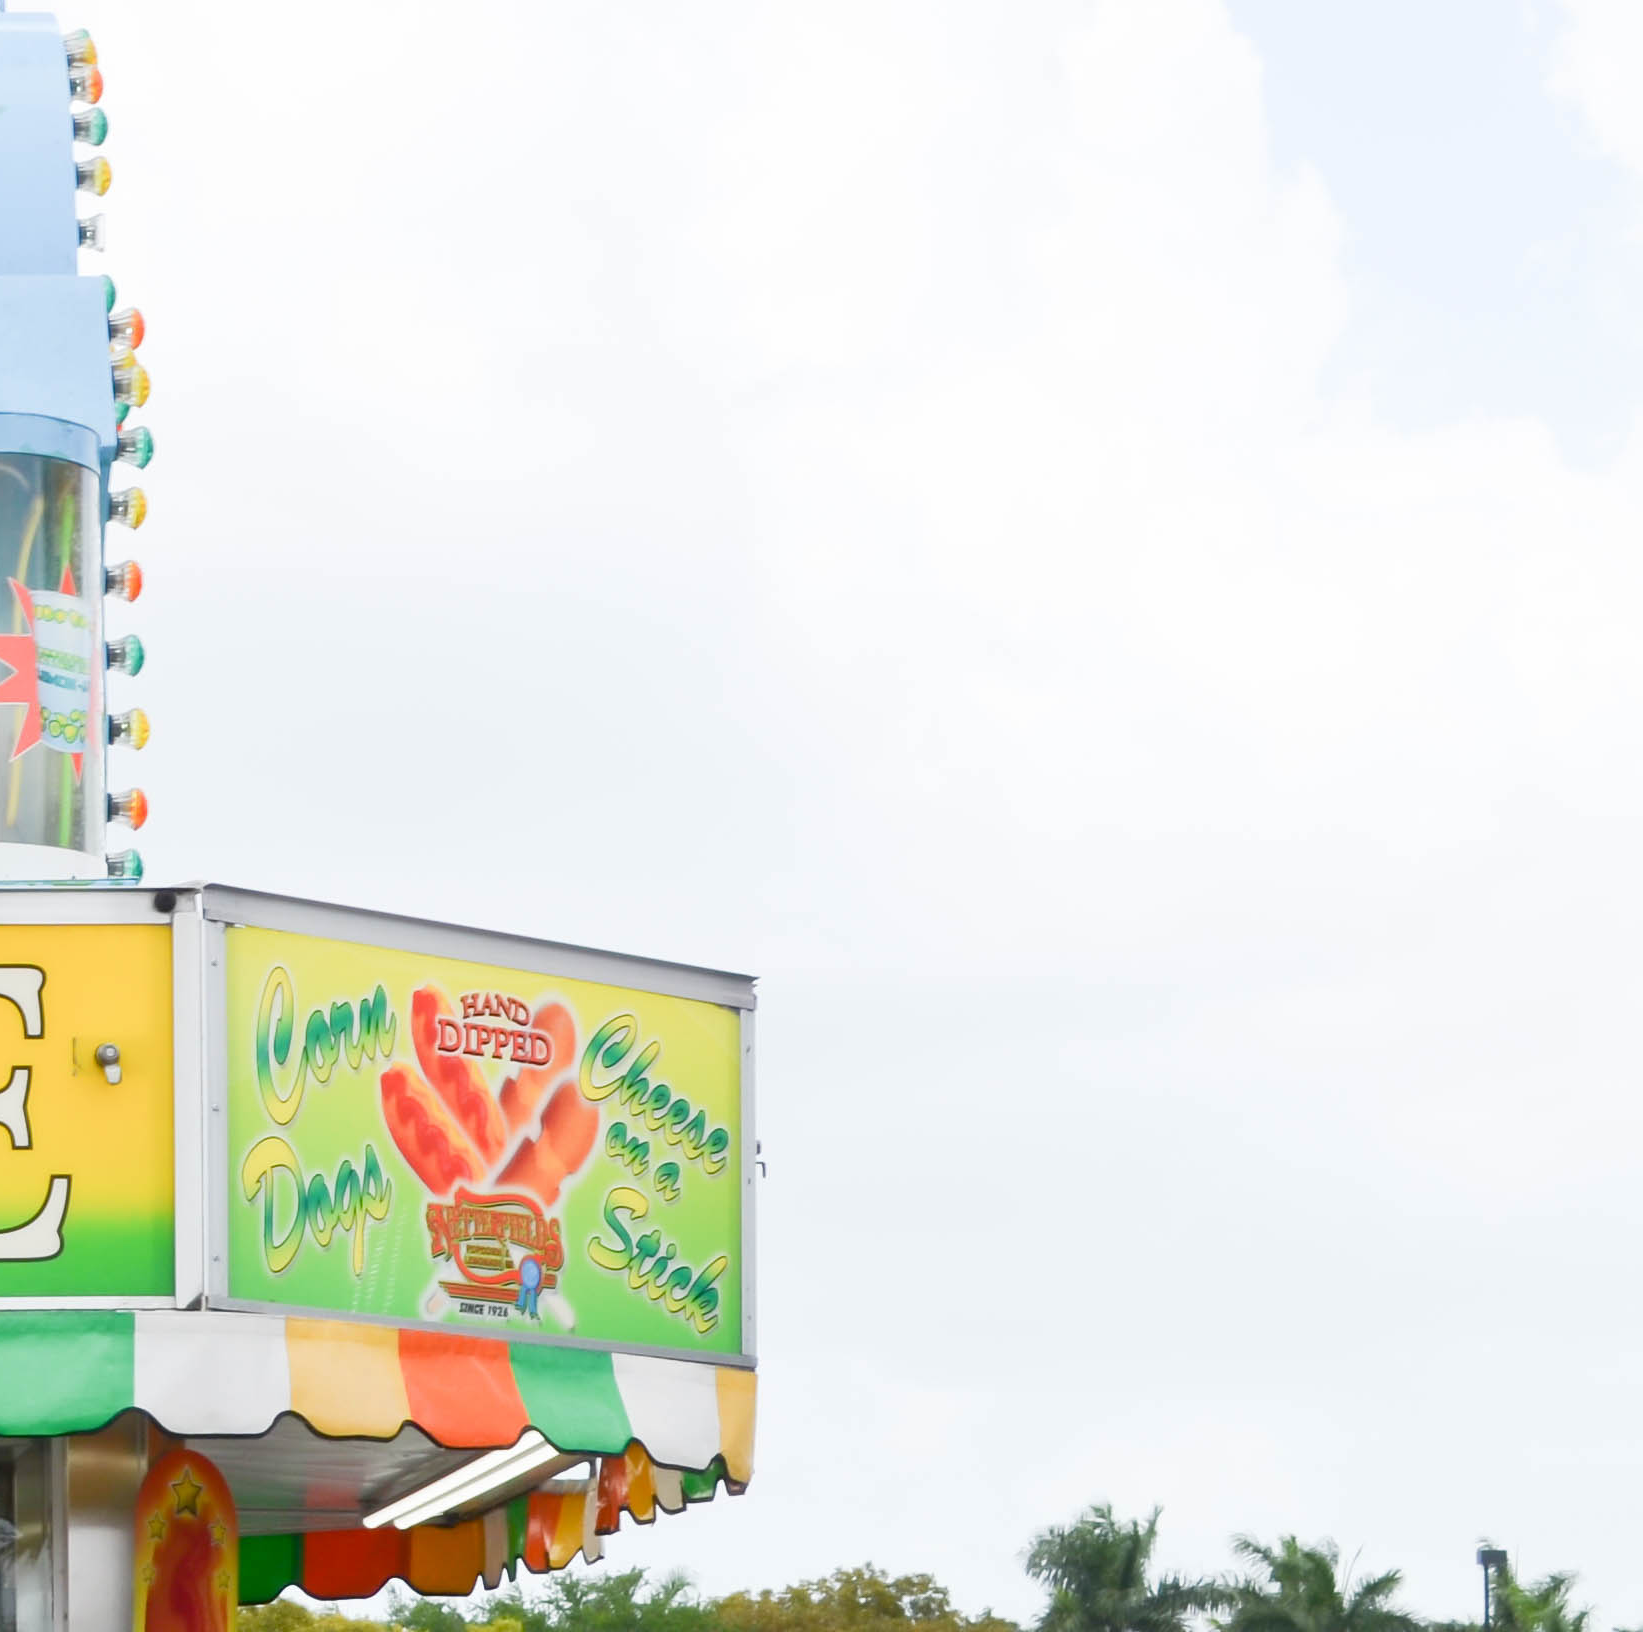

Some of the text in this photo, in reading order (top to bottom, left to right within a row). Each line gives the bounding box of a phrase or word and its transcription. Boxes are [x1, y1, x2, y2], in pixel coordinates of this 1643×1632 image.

[256, 965, 397, 1126] Corn
[437, 1017, 553, 1067] DIPPED
[460, 992, 530, 1027] HAND
[578, 1013, 730, 1175] Cheese
[242, 1136, 393, 1277] Dogs
[605, 1122, 682, 1202] on a
[459, 1302, 509, 1318] SINCE 1926
[588, 1187, 728, 1334] Stick
